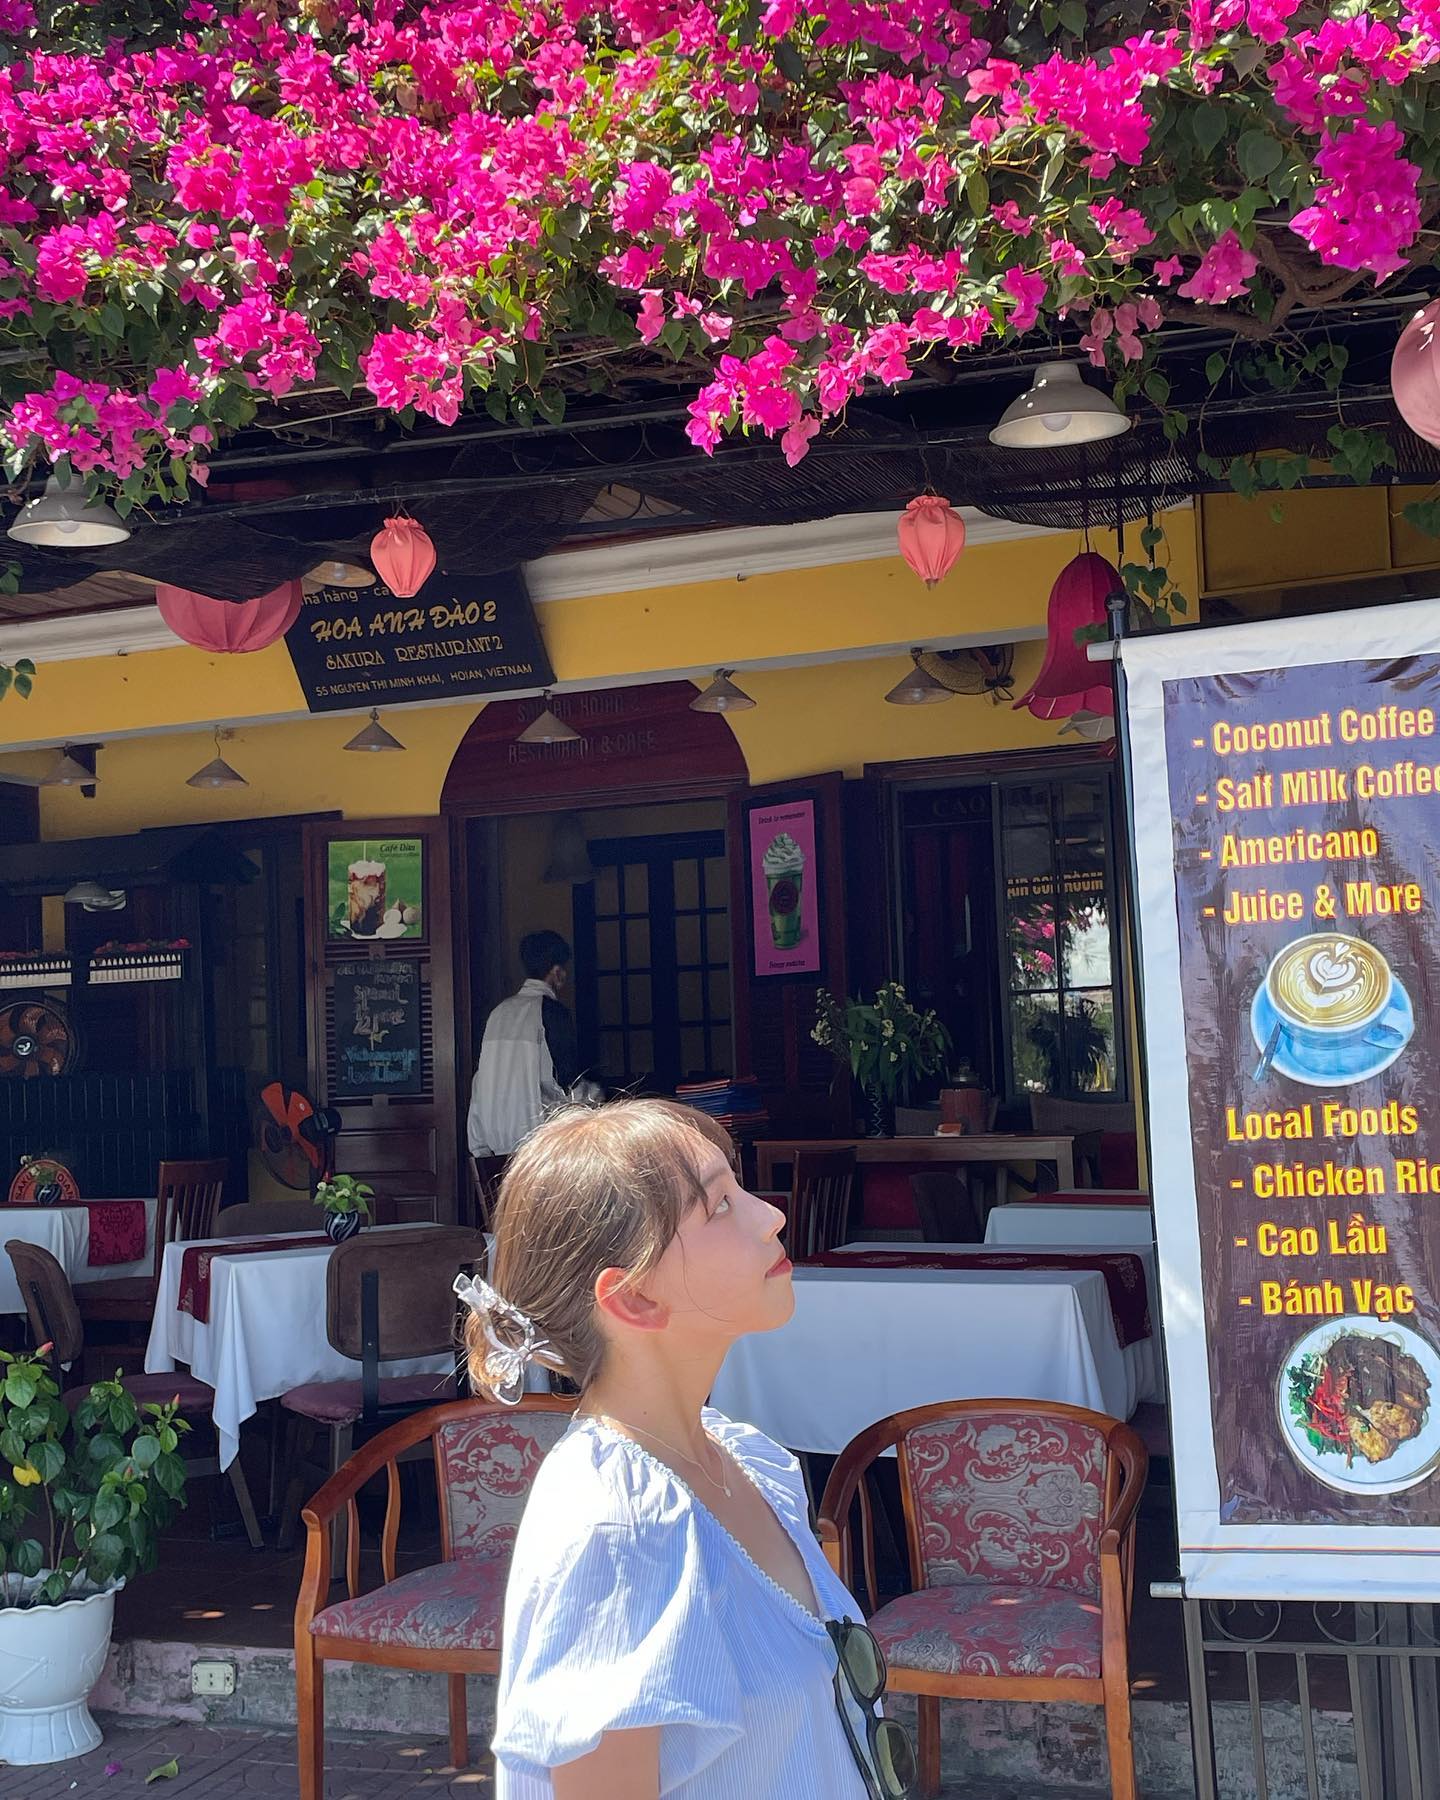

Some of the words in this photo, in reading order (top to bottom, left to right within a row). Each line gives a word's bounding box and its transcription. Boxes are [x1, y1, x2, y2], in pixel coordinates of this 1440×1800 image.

[310, 616, 363, 643] HOA
[368, 608, 427, 636] ANH
[325, 650, 386, 671] SAKURA
[329, 681, 370, 695] NGUYEN
[371, 680, 388, 690] THI
[389, 677, 415, 689] MINH
[485, 663, 533, 677] VIETNAM
[1213, 713, 1333, 755] Coconut
[1340, 705, 1435, 743] Coffee
[1281, 767, 1348, 806] Milk
[1220, 827, 1380, 868] Americano
[1223, 888, 1304, 926] Juice
[1313, 884, 1337, 919] &
[1345, 881, 1422, 917] More
[1225, 1103, 1313, 1142] Local
[1323, 1100, 1419, 1138] Foods
[1253, 1160, 1386, 1199] Chicken
[1257, 1221, 1319, 1257] Cao
[1328, 1213, 1388, 1256] Lầu
[1260, 1279, 1345, 1316] Bánh
[1351, 1279, 1415, 1322] Vạc
